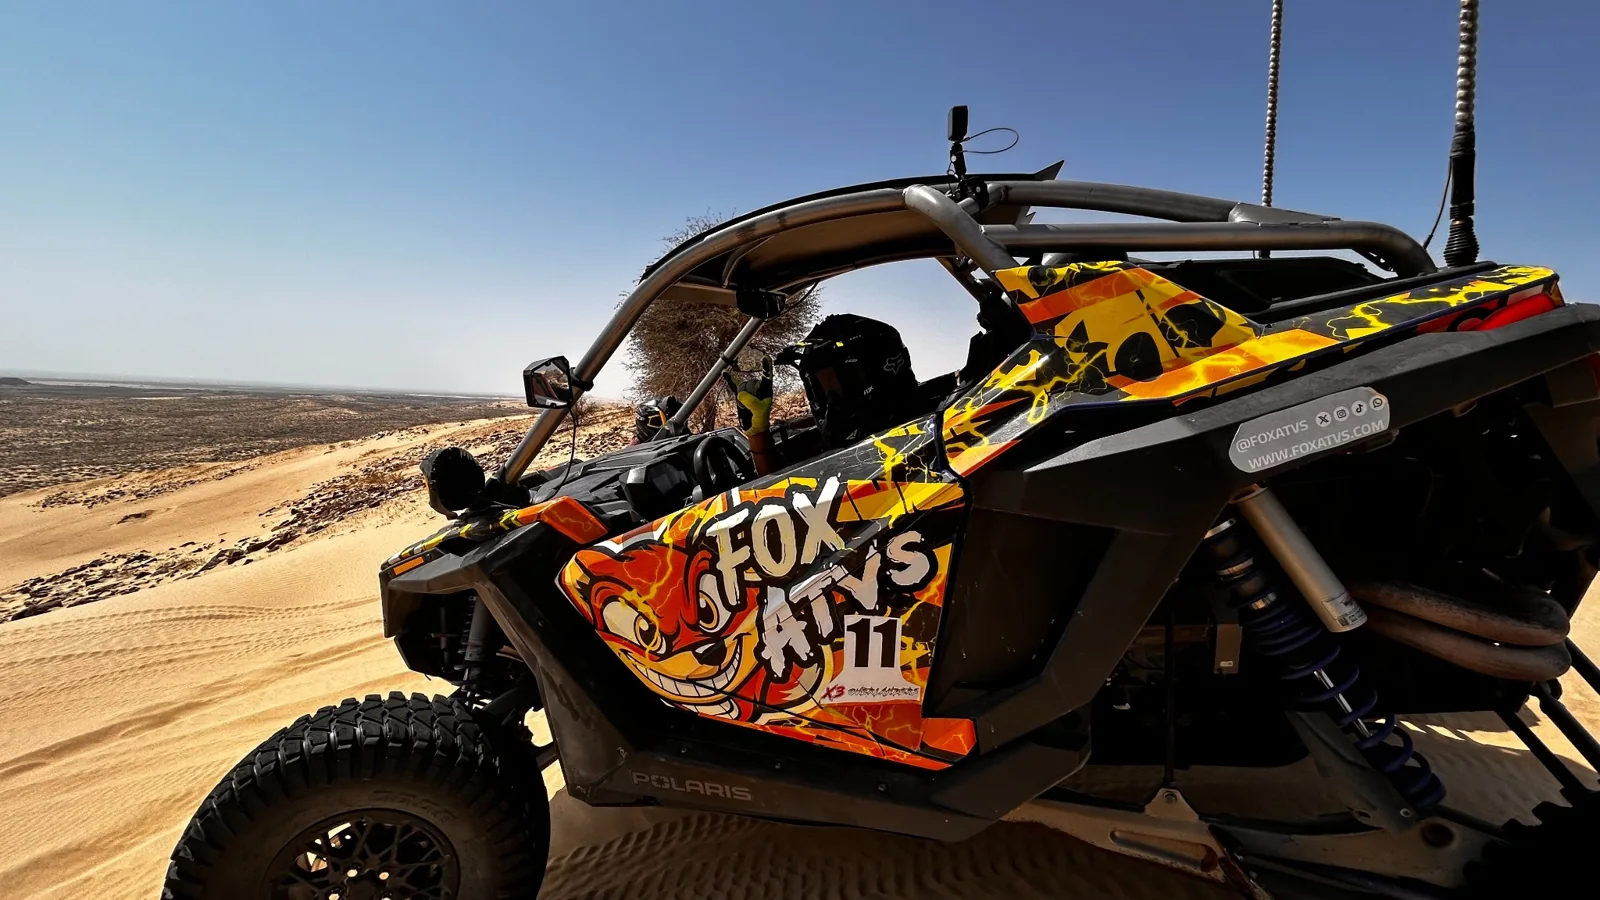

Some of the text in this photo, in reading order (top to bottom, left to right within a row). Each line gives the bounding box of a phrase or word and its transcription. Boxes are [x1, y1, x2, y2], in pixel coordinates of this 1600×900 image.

[1236, 419, 1309, 453] @FOXATVS
[1248, 419, 1385, 470] WWW.FOXATVS.COM
[705, 474, 846, 606] FOX
[846, 617, 899, 668] 11
[819, 684, 846, 702] X3
[631, 771, 753, 801] POLARIS
